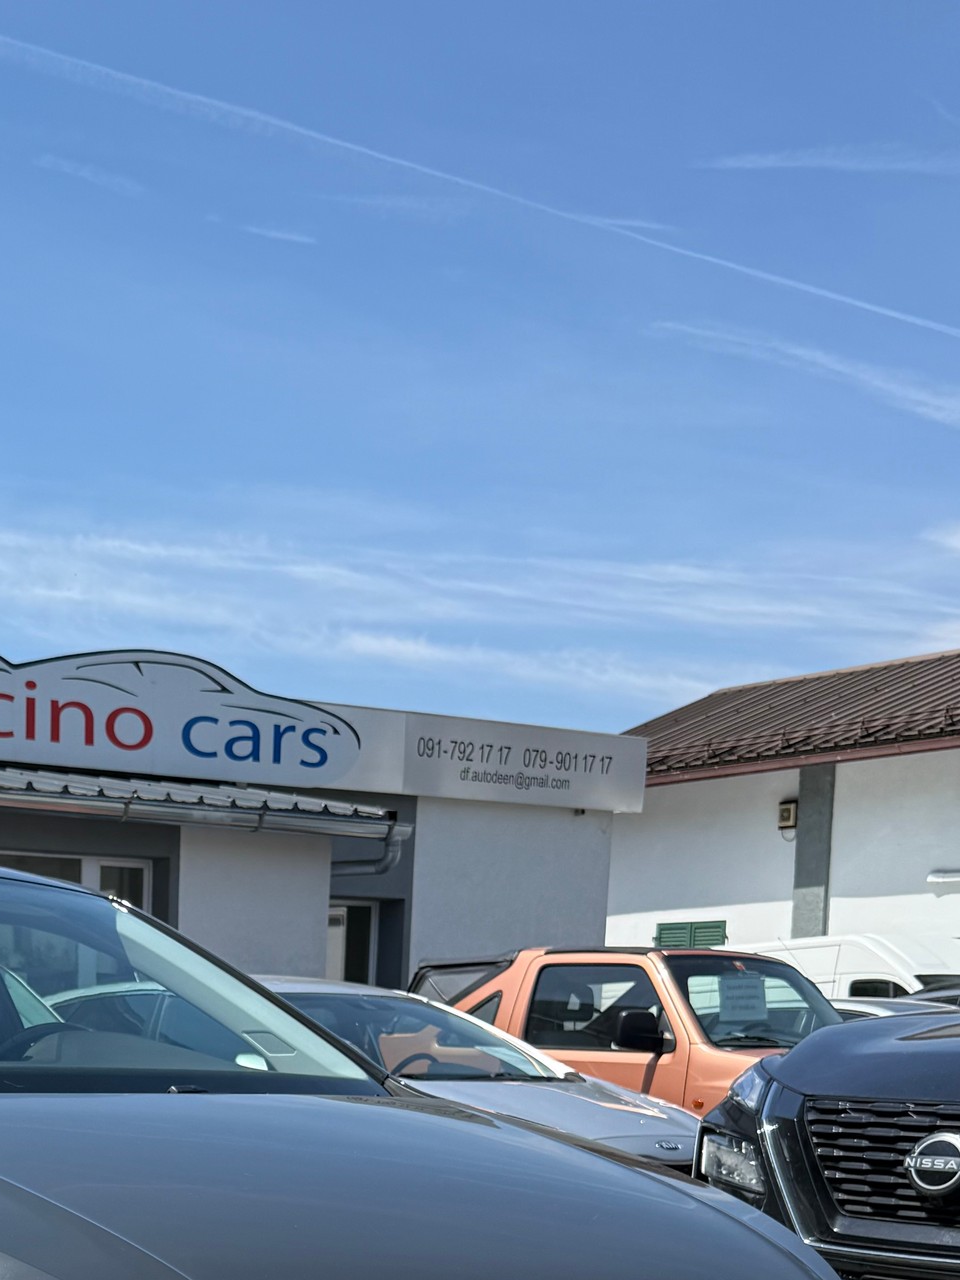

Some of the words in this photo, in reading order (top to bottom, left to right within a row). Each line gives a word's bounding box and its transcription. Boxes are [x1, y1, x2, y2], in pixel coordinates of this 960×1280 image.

[181, 714, 329, 769] cars
[417, 736, 474, 763] 091-792
[479, 744, 493, 765] 17
[497, 746, 511, 766] 17
[905, 1157, 960, 1170] NISSA
